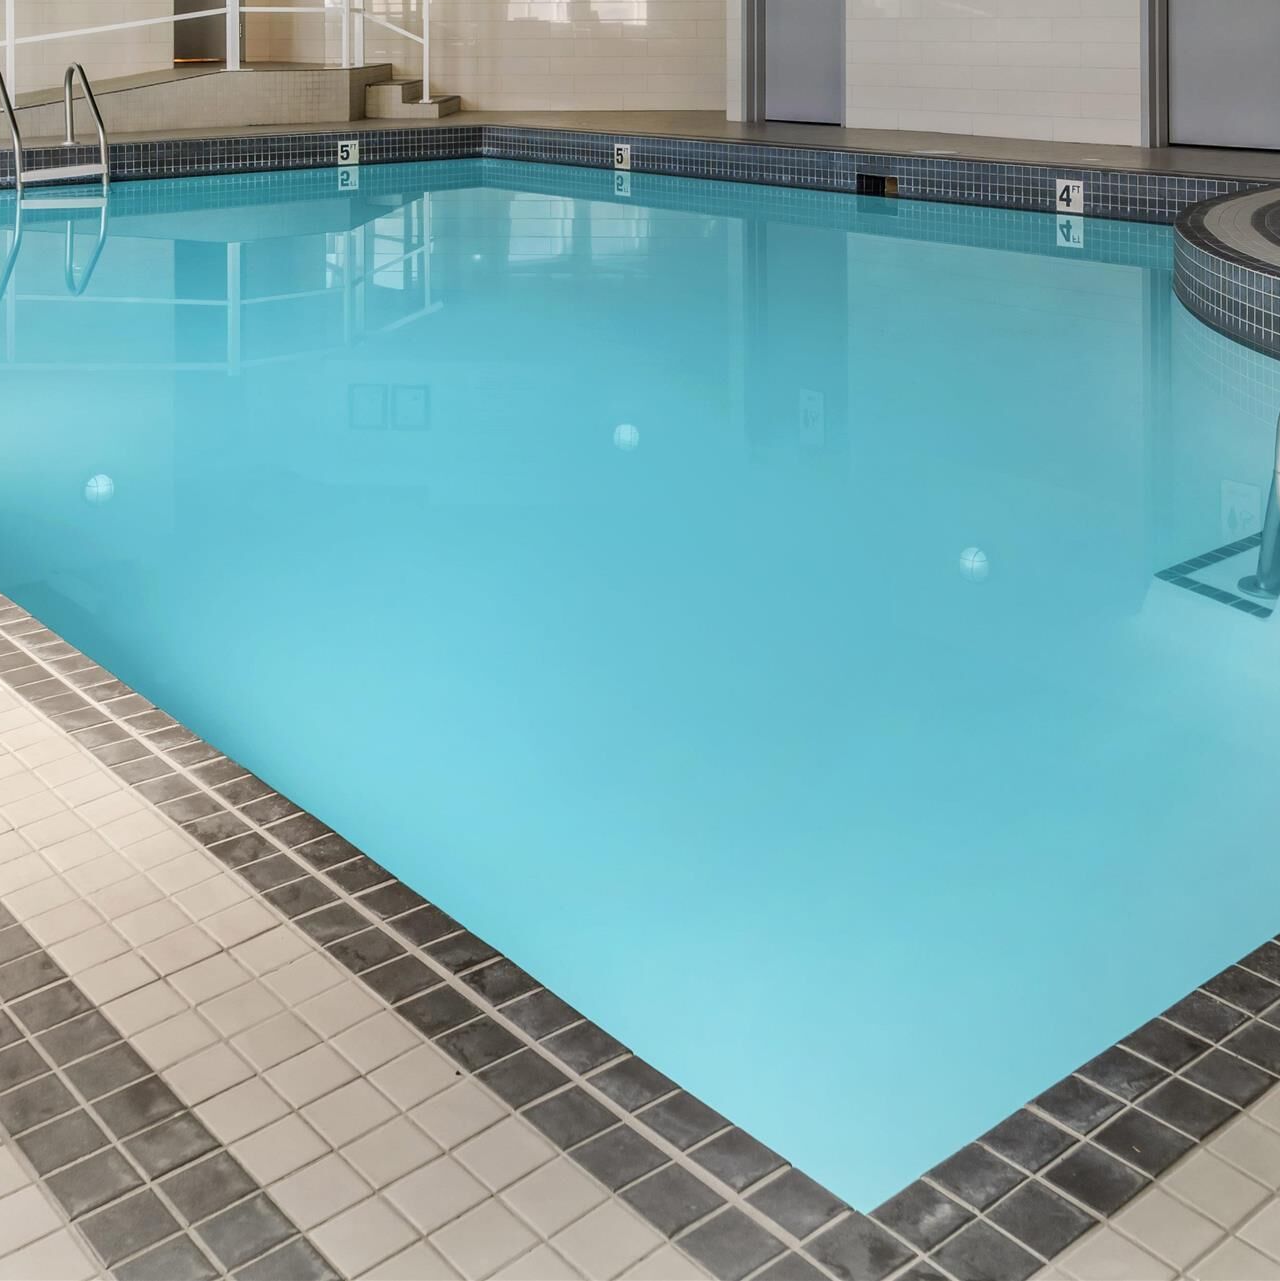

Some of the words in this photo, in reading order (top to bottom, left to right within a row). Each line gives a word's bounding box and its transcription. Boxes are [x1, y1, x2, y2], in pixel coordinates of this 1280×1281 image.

[340, 144, 350, 161] 5
[616, 147, 624, 164] 5
[1059, 185, 1072, 207] 4
[1072, 185, 1080, 194] FT
